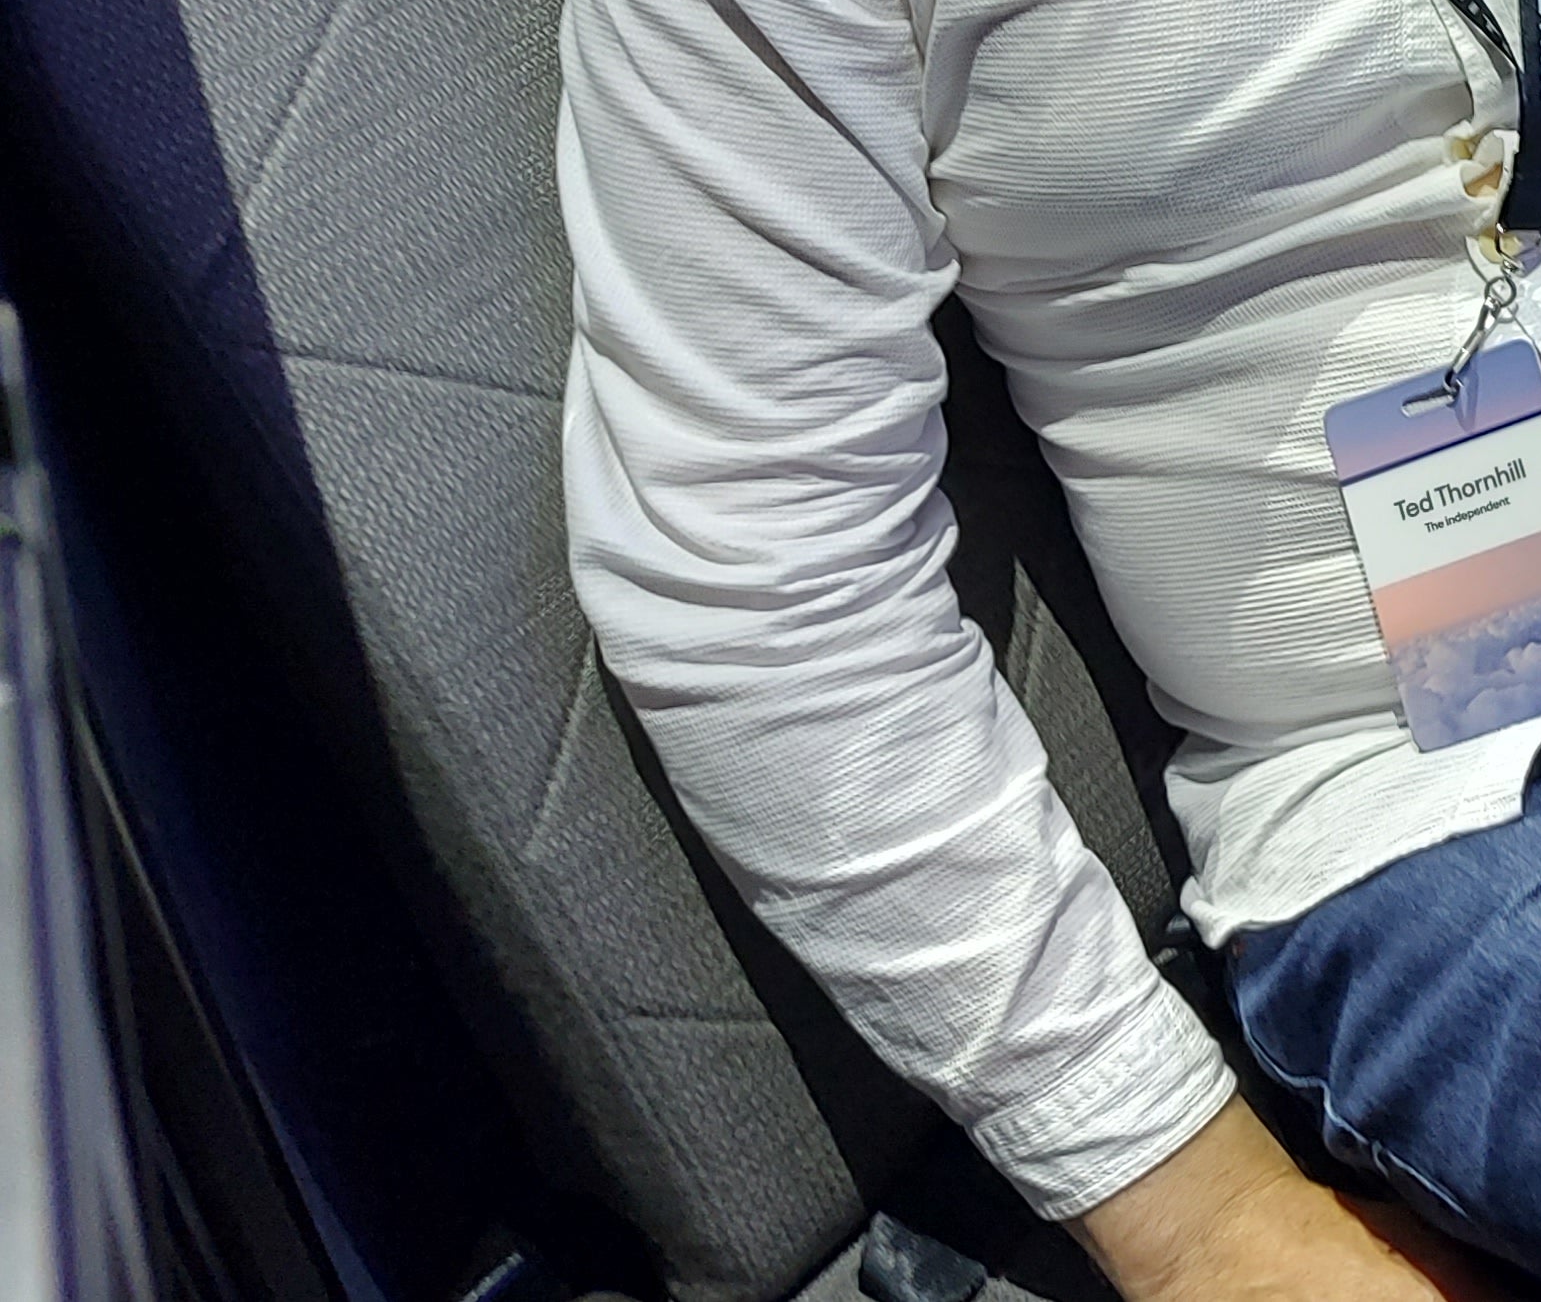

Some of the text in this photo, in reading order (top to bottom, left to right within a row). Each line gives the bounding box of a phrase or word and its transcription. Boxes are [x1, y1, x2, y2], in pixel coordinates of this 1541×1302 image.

[1393, 457, 1527, 521] Ted Thornhill
[1424, 521, 1445, 533] The
